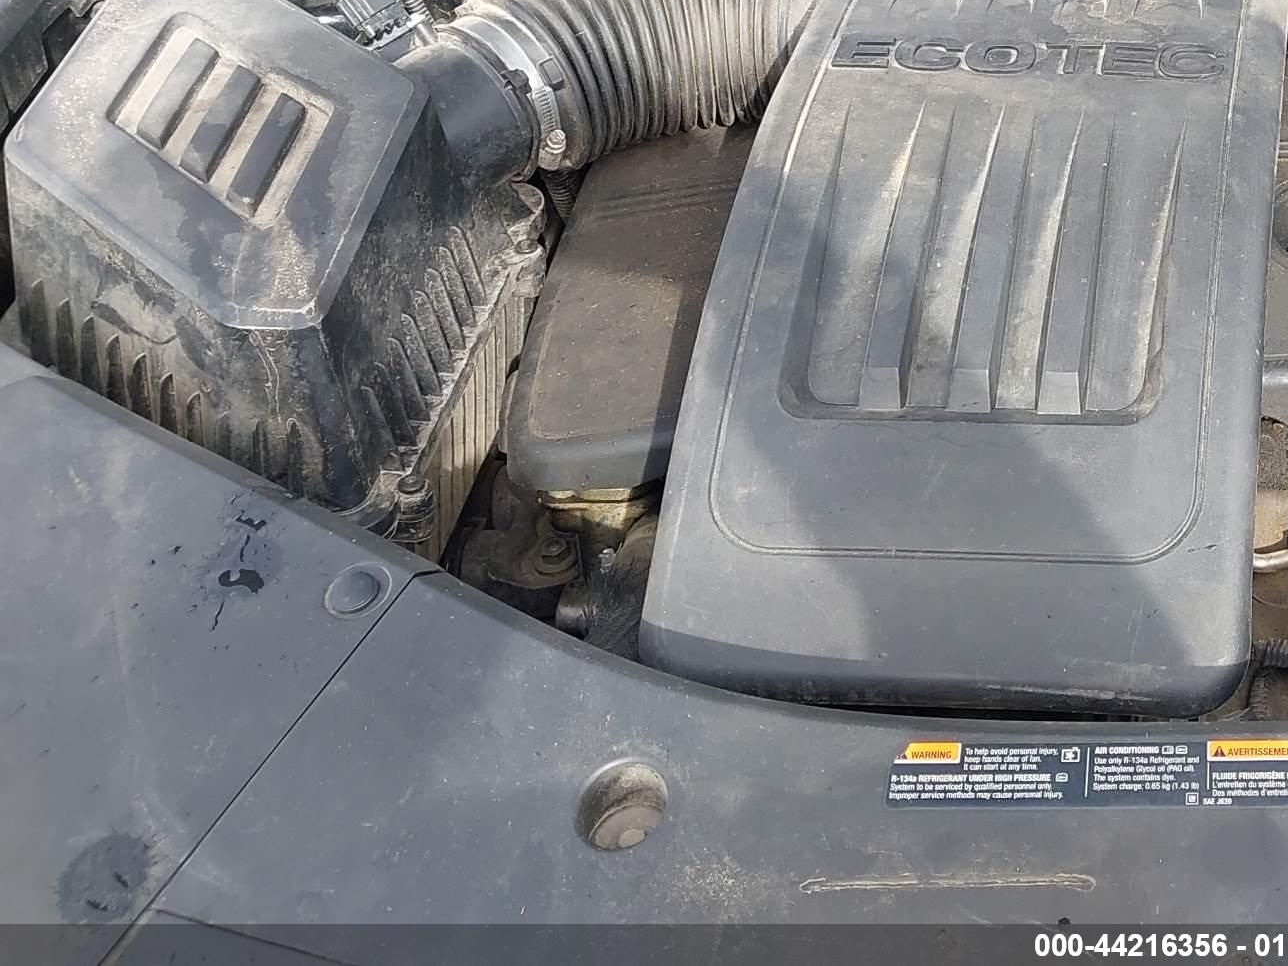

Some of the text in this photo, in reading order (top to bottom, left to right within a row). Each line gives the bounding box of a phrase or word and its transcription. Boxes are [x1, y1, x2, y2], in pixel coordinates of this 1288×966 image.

[831, 37, 1225, 80] ECOTEC
[974, 748, 988, 756] help
[1009, 748, 1038, 756] personal
[1039, 748, 1058, 756] injury,
[1095, 746, 1159, 754] AIR CONDITIONING
[911, 751, 952, 759] WARNING
[1109, 757, 1121, 765] only
[1150, 756, 1185, 764] Refrigerant
[1136, 765, 1155, 773] Glycol
[919, 774, 967, 782] REFRIGERANT
[969, 774, 993, 782] UNDER
[995, 774, 1012, 782] HIGH
[1014, 774, 1051, 782] PRESSURE
[1212, 772, 1237, 780] FLUIDE
[890, 784, 915, 792] System
[935, 783, 962, 791] serviced
[965, 783, 972, 791] by
[974, 783, 1002, 791] qualified
[1004, 783, 1036, 791] personnel
[1093, 783, 1117, 791] System
[1162, 783, 1170, 791] kg
[1258, 780, 1286, 789] système
[889, 792, 919, 800] Improper
[977, 792, 990, 800] may
[1013, 791, 1042, 799] personal
[1044, 791, 1063, 799] injury.
